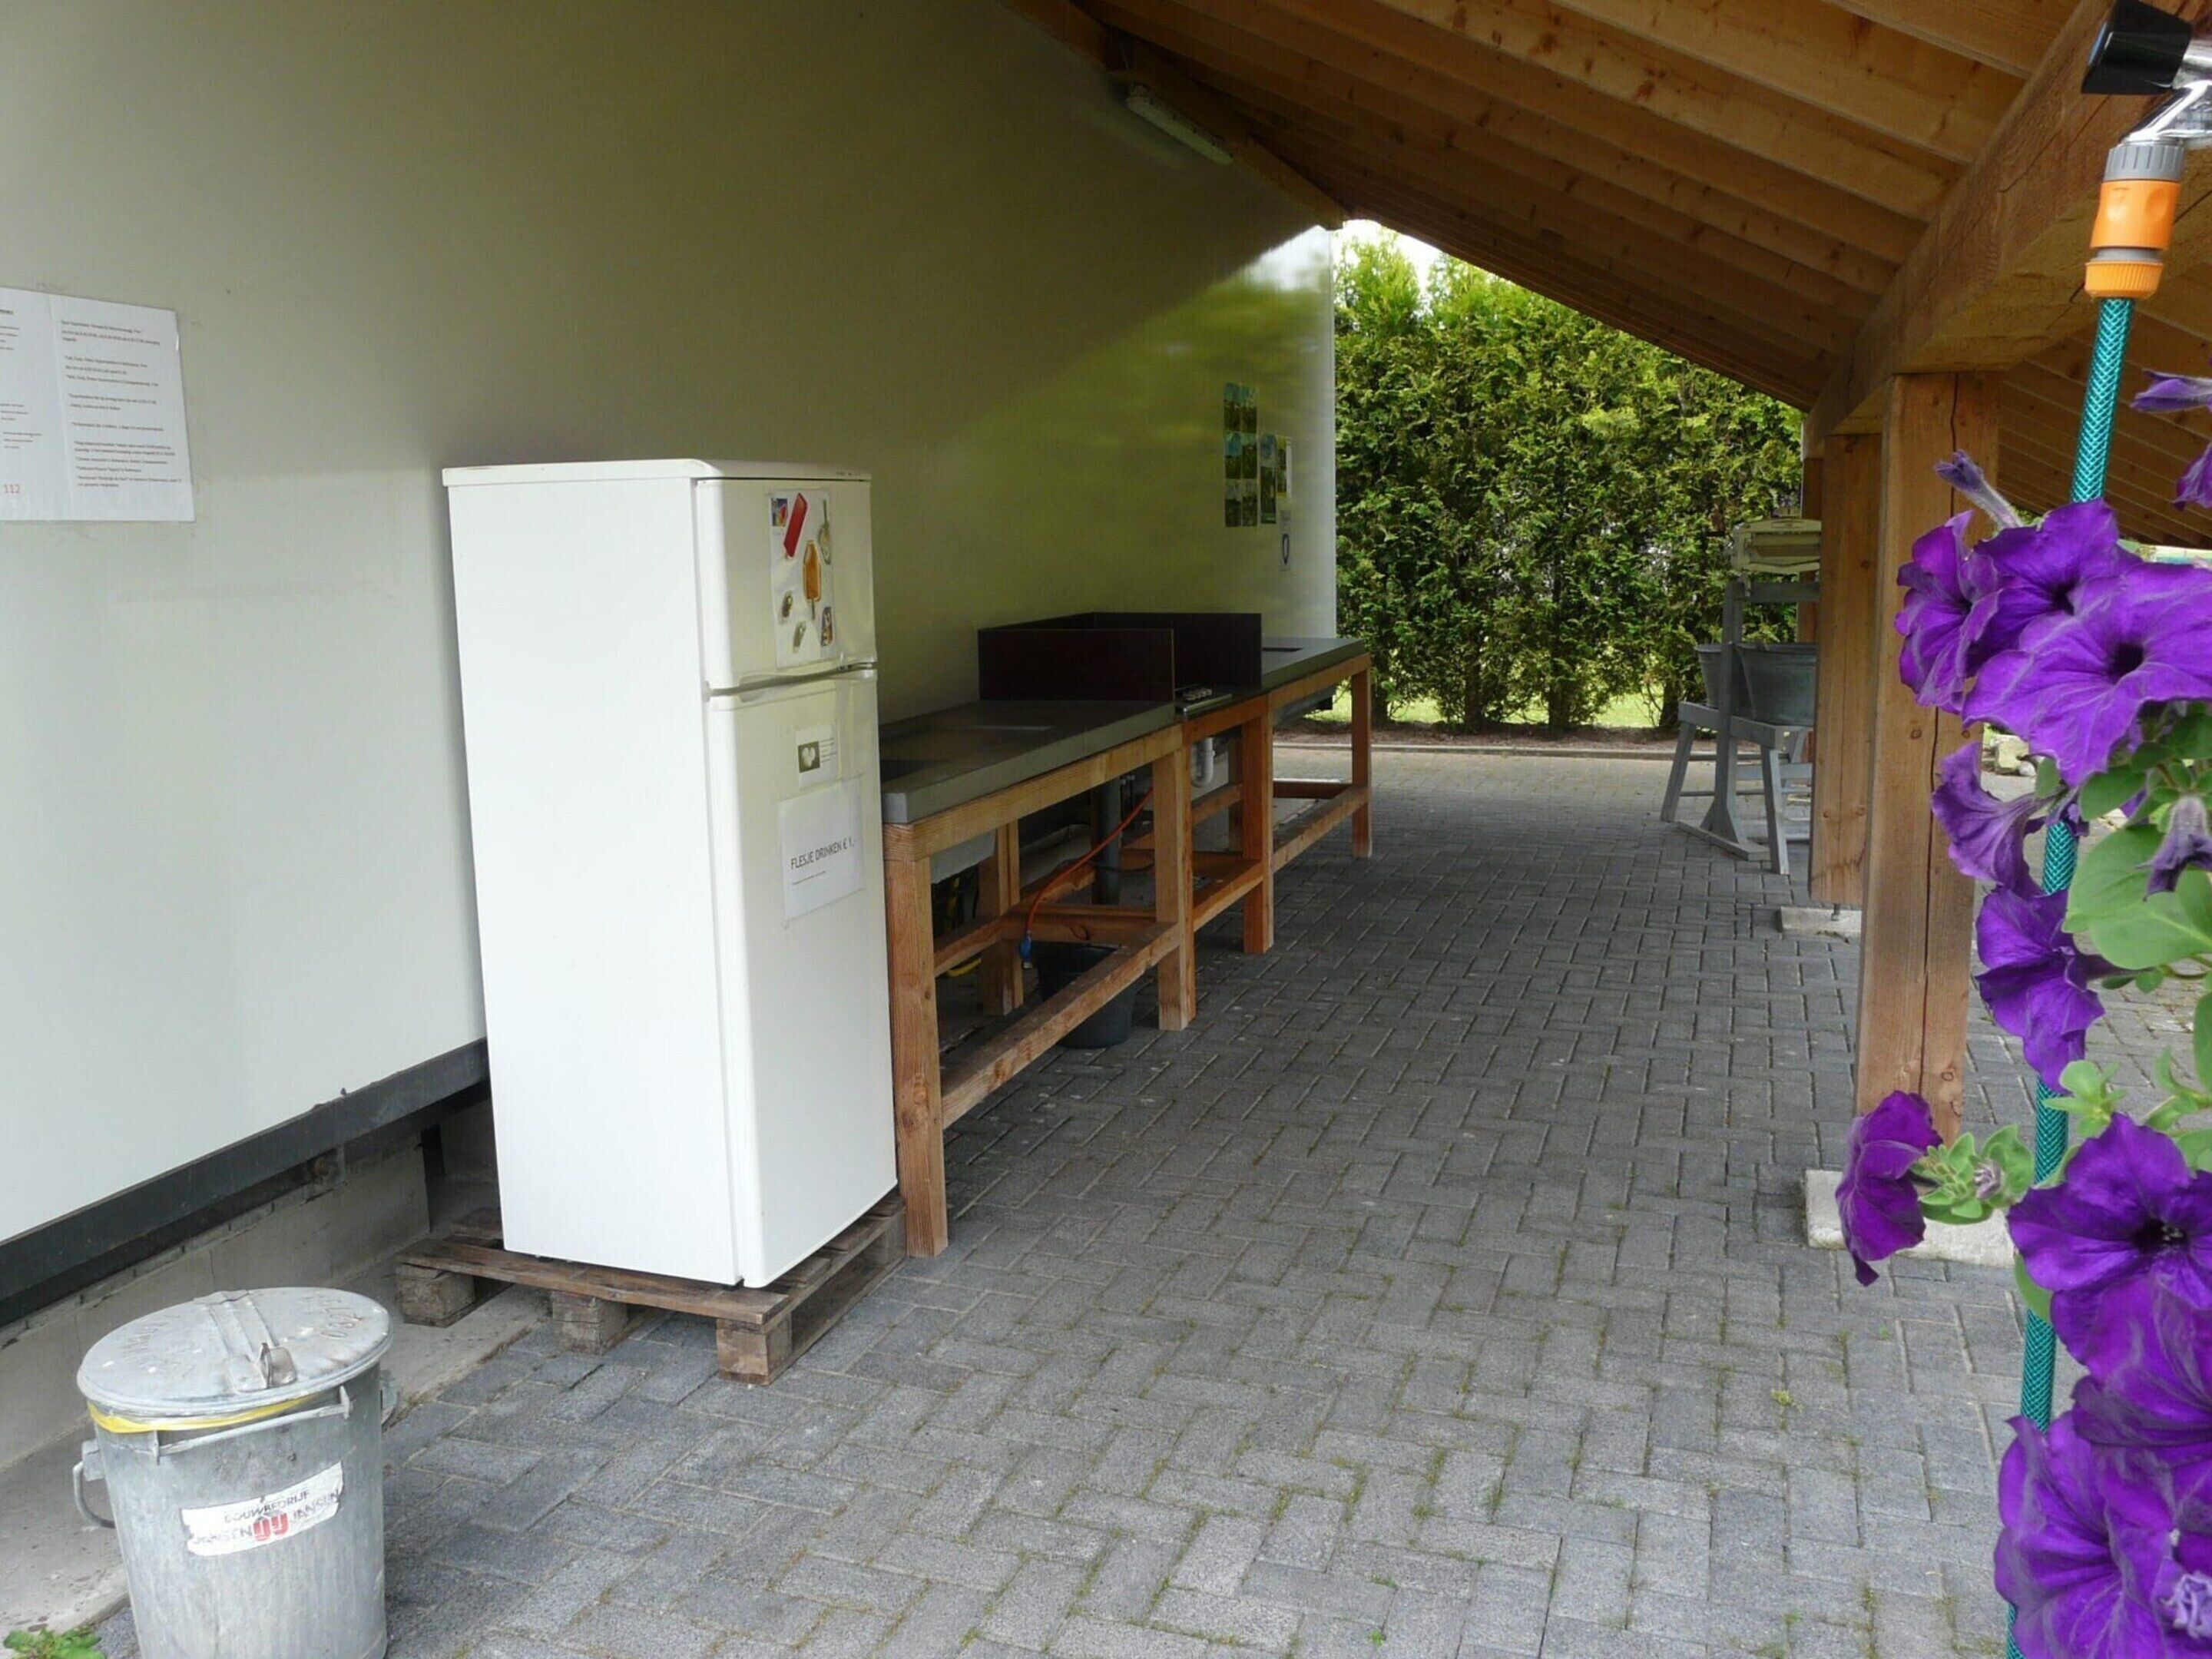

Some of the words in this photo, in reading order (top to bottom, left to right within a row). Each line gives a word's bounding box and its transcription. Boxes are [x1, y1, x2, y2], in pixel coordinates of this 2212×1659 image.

[4, 484, 21, 494] 112
[790, 851, 814, 869] FLESJE
[815, 842, 842, 860] DRINKEN
